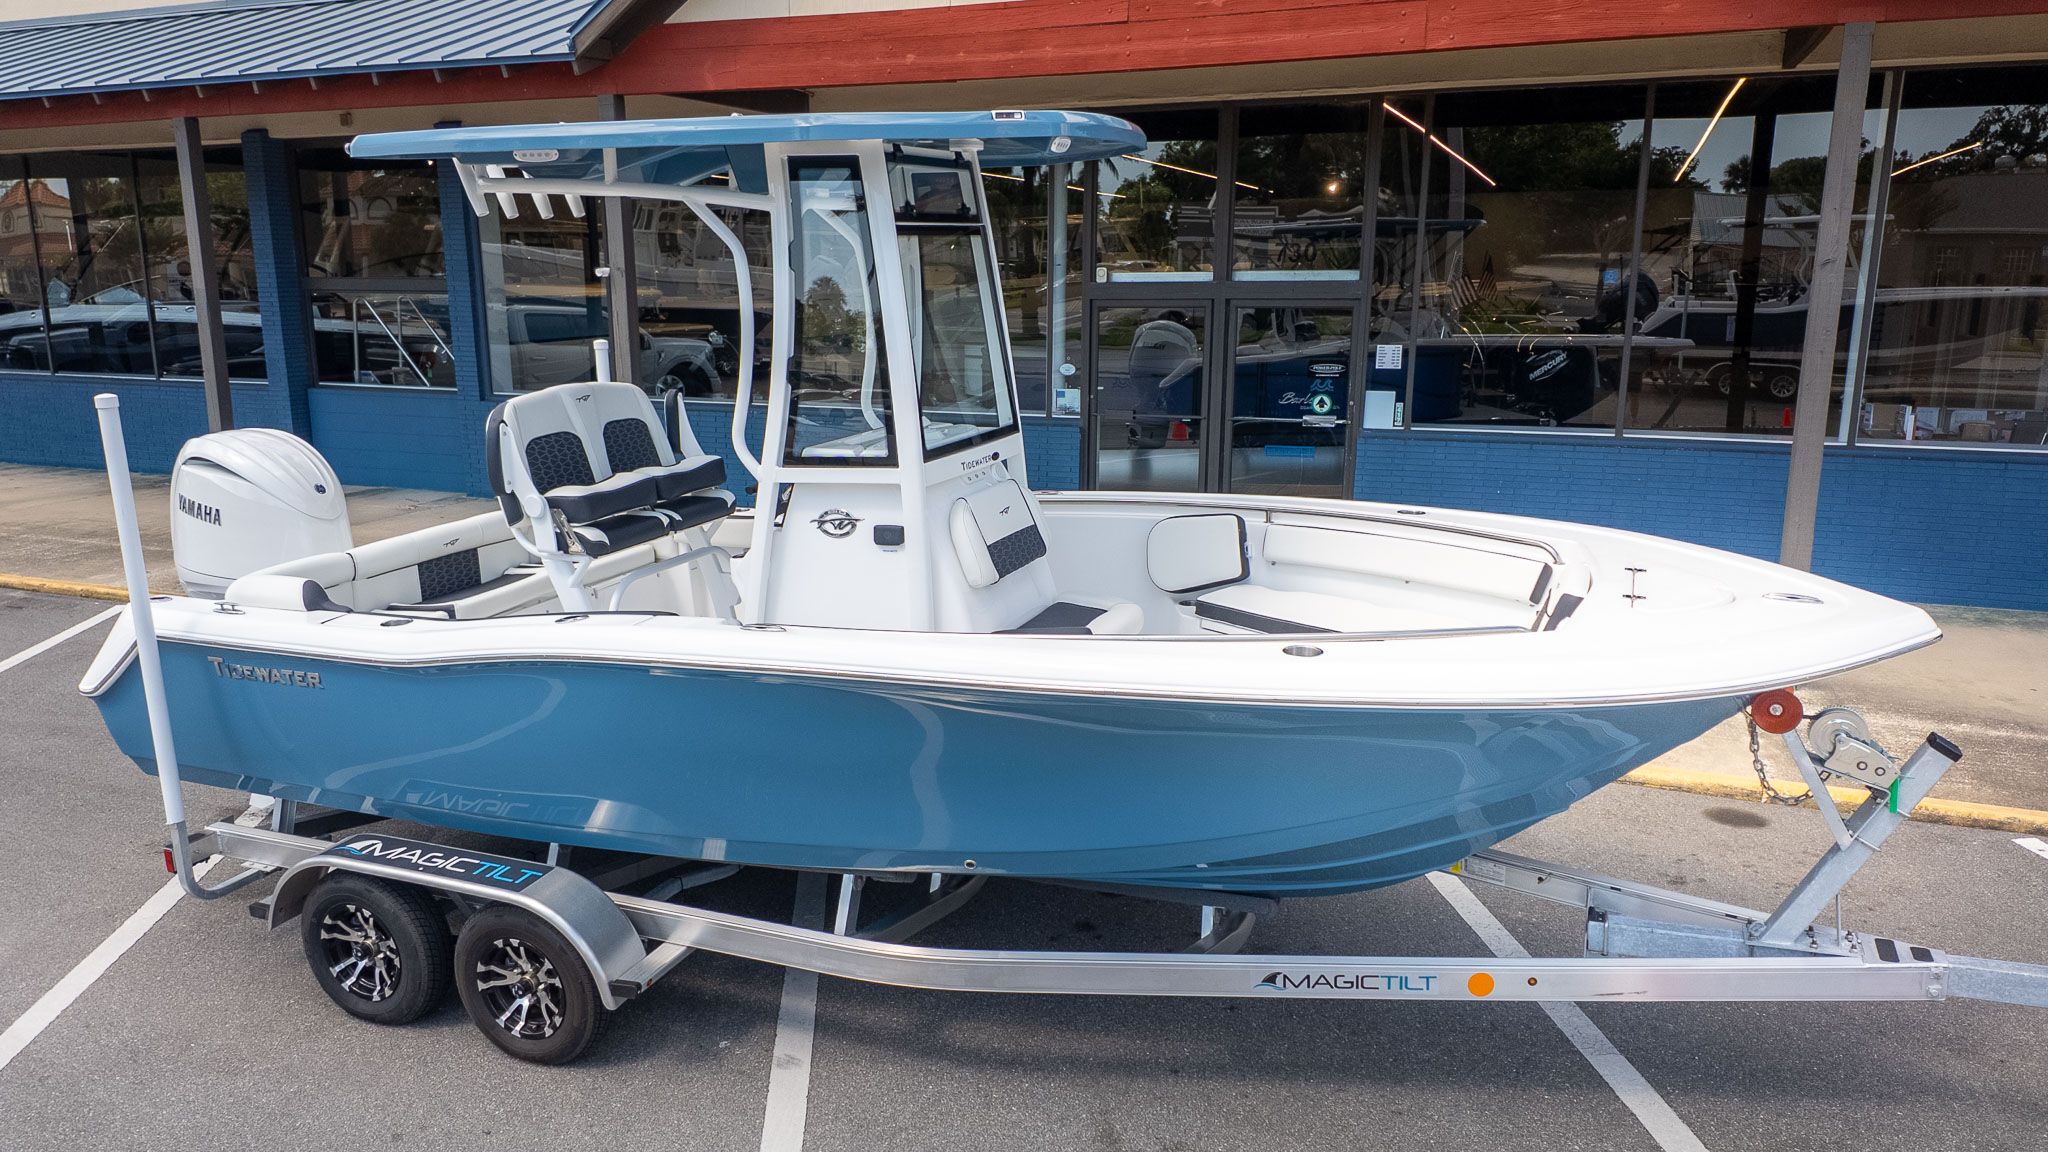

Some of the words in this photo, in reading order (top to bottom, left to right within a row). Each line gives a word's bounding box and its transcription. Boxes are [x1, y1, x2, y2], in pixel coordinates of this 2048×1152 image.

[1529, 351, 1568, 381] MERCURY
[178, 493, 222, 527] YAMAHA
[207, 656, 325, 689] TIDEWATER
[361, 842, 543, 884] MAGICTILT
[1282, 974, 1438, 990] MAGICTILT
